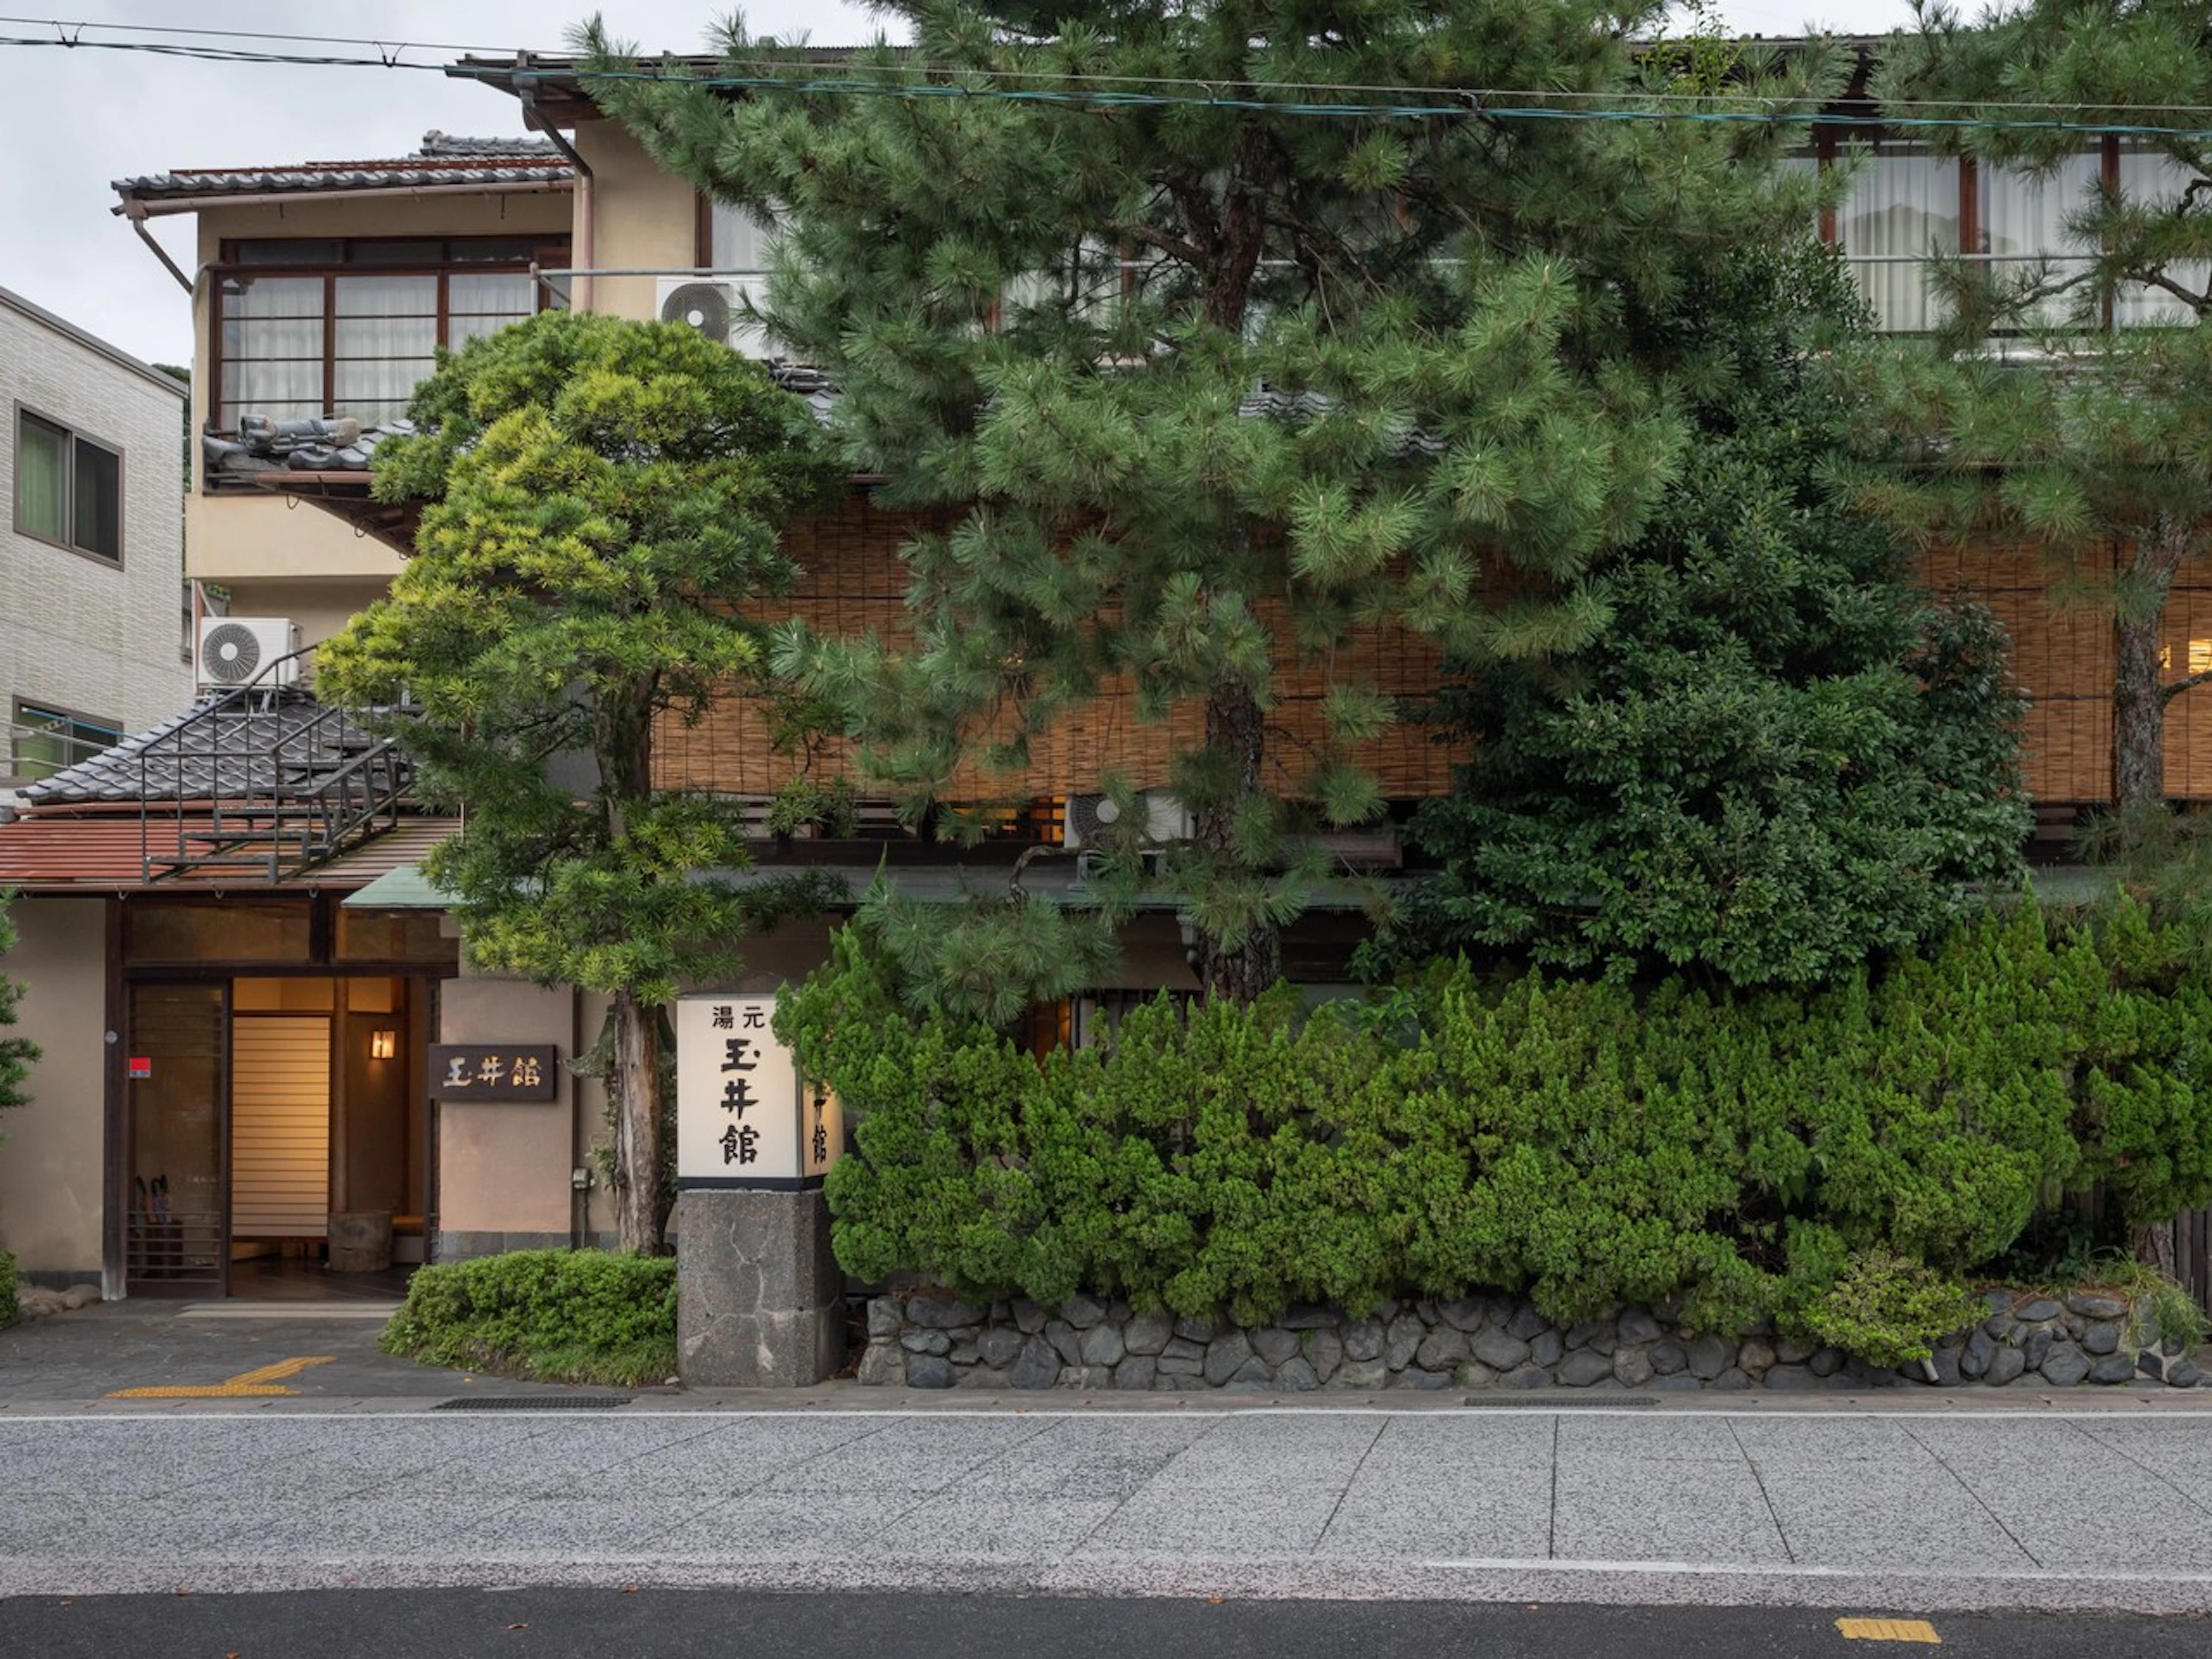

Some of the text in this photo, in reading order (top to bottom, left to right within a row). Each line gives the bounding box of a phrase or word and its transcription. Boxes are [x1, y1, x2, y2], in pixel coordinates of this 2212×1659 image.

[713, 1006, 765, 1029] 湯元
[442, 1056, 541, 1087] 玉井館
[719, 1039, 760, 1165] 玉井館
